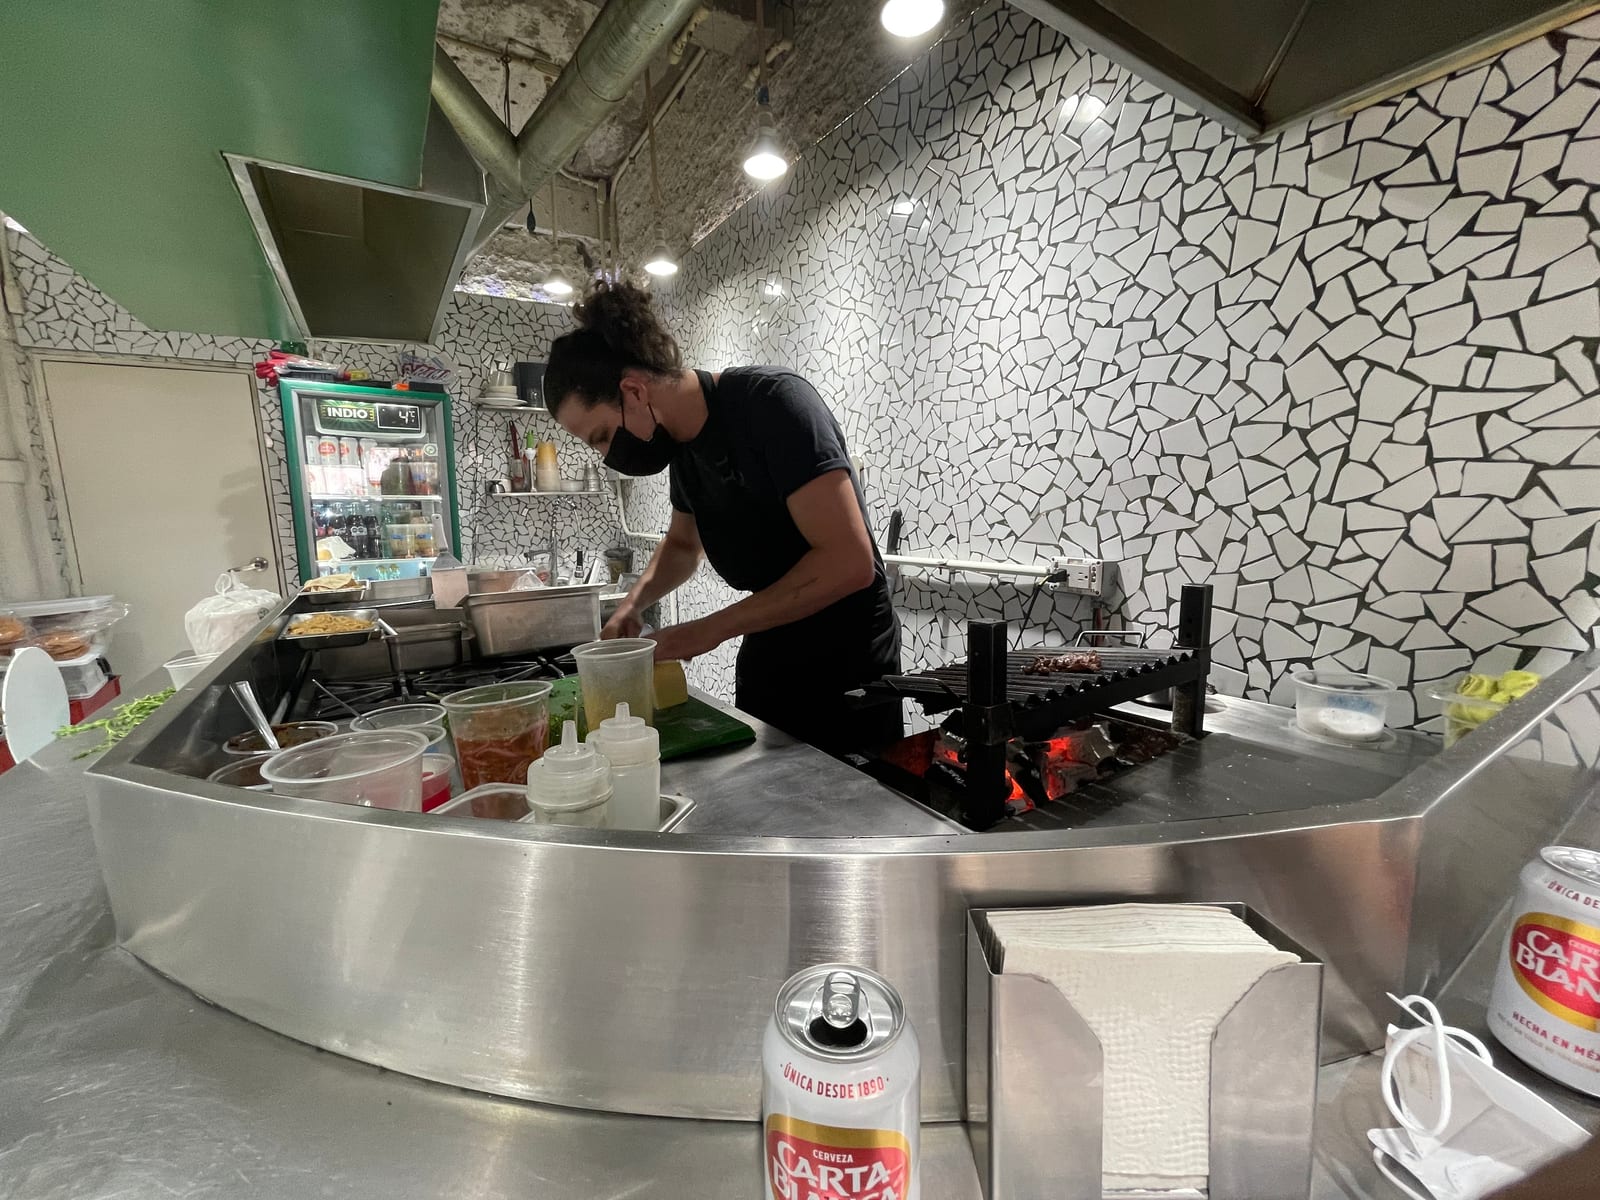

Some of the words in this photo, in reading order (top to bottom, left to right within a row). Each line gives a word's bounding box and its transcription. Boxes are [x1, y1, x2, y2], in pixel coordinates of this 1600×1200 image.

[327, 407, 368, 419] INDIO
[1547, 880, 1580, 901] ÚNICA
[1512, 1011, 1548, 1039] HECHA
[1552, 1035, 1569, 1049] EN
[783, 1062, 813, 1093] ÚNICA
[817, 1081, 854, 1099] DESDE
[858, 1076, 885, 1097] 1890
[777, 1141, 890, 1197] CARTA
[813, 1149, 854, 1163] CERVEZA
